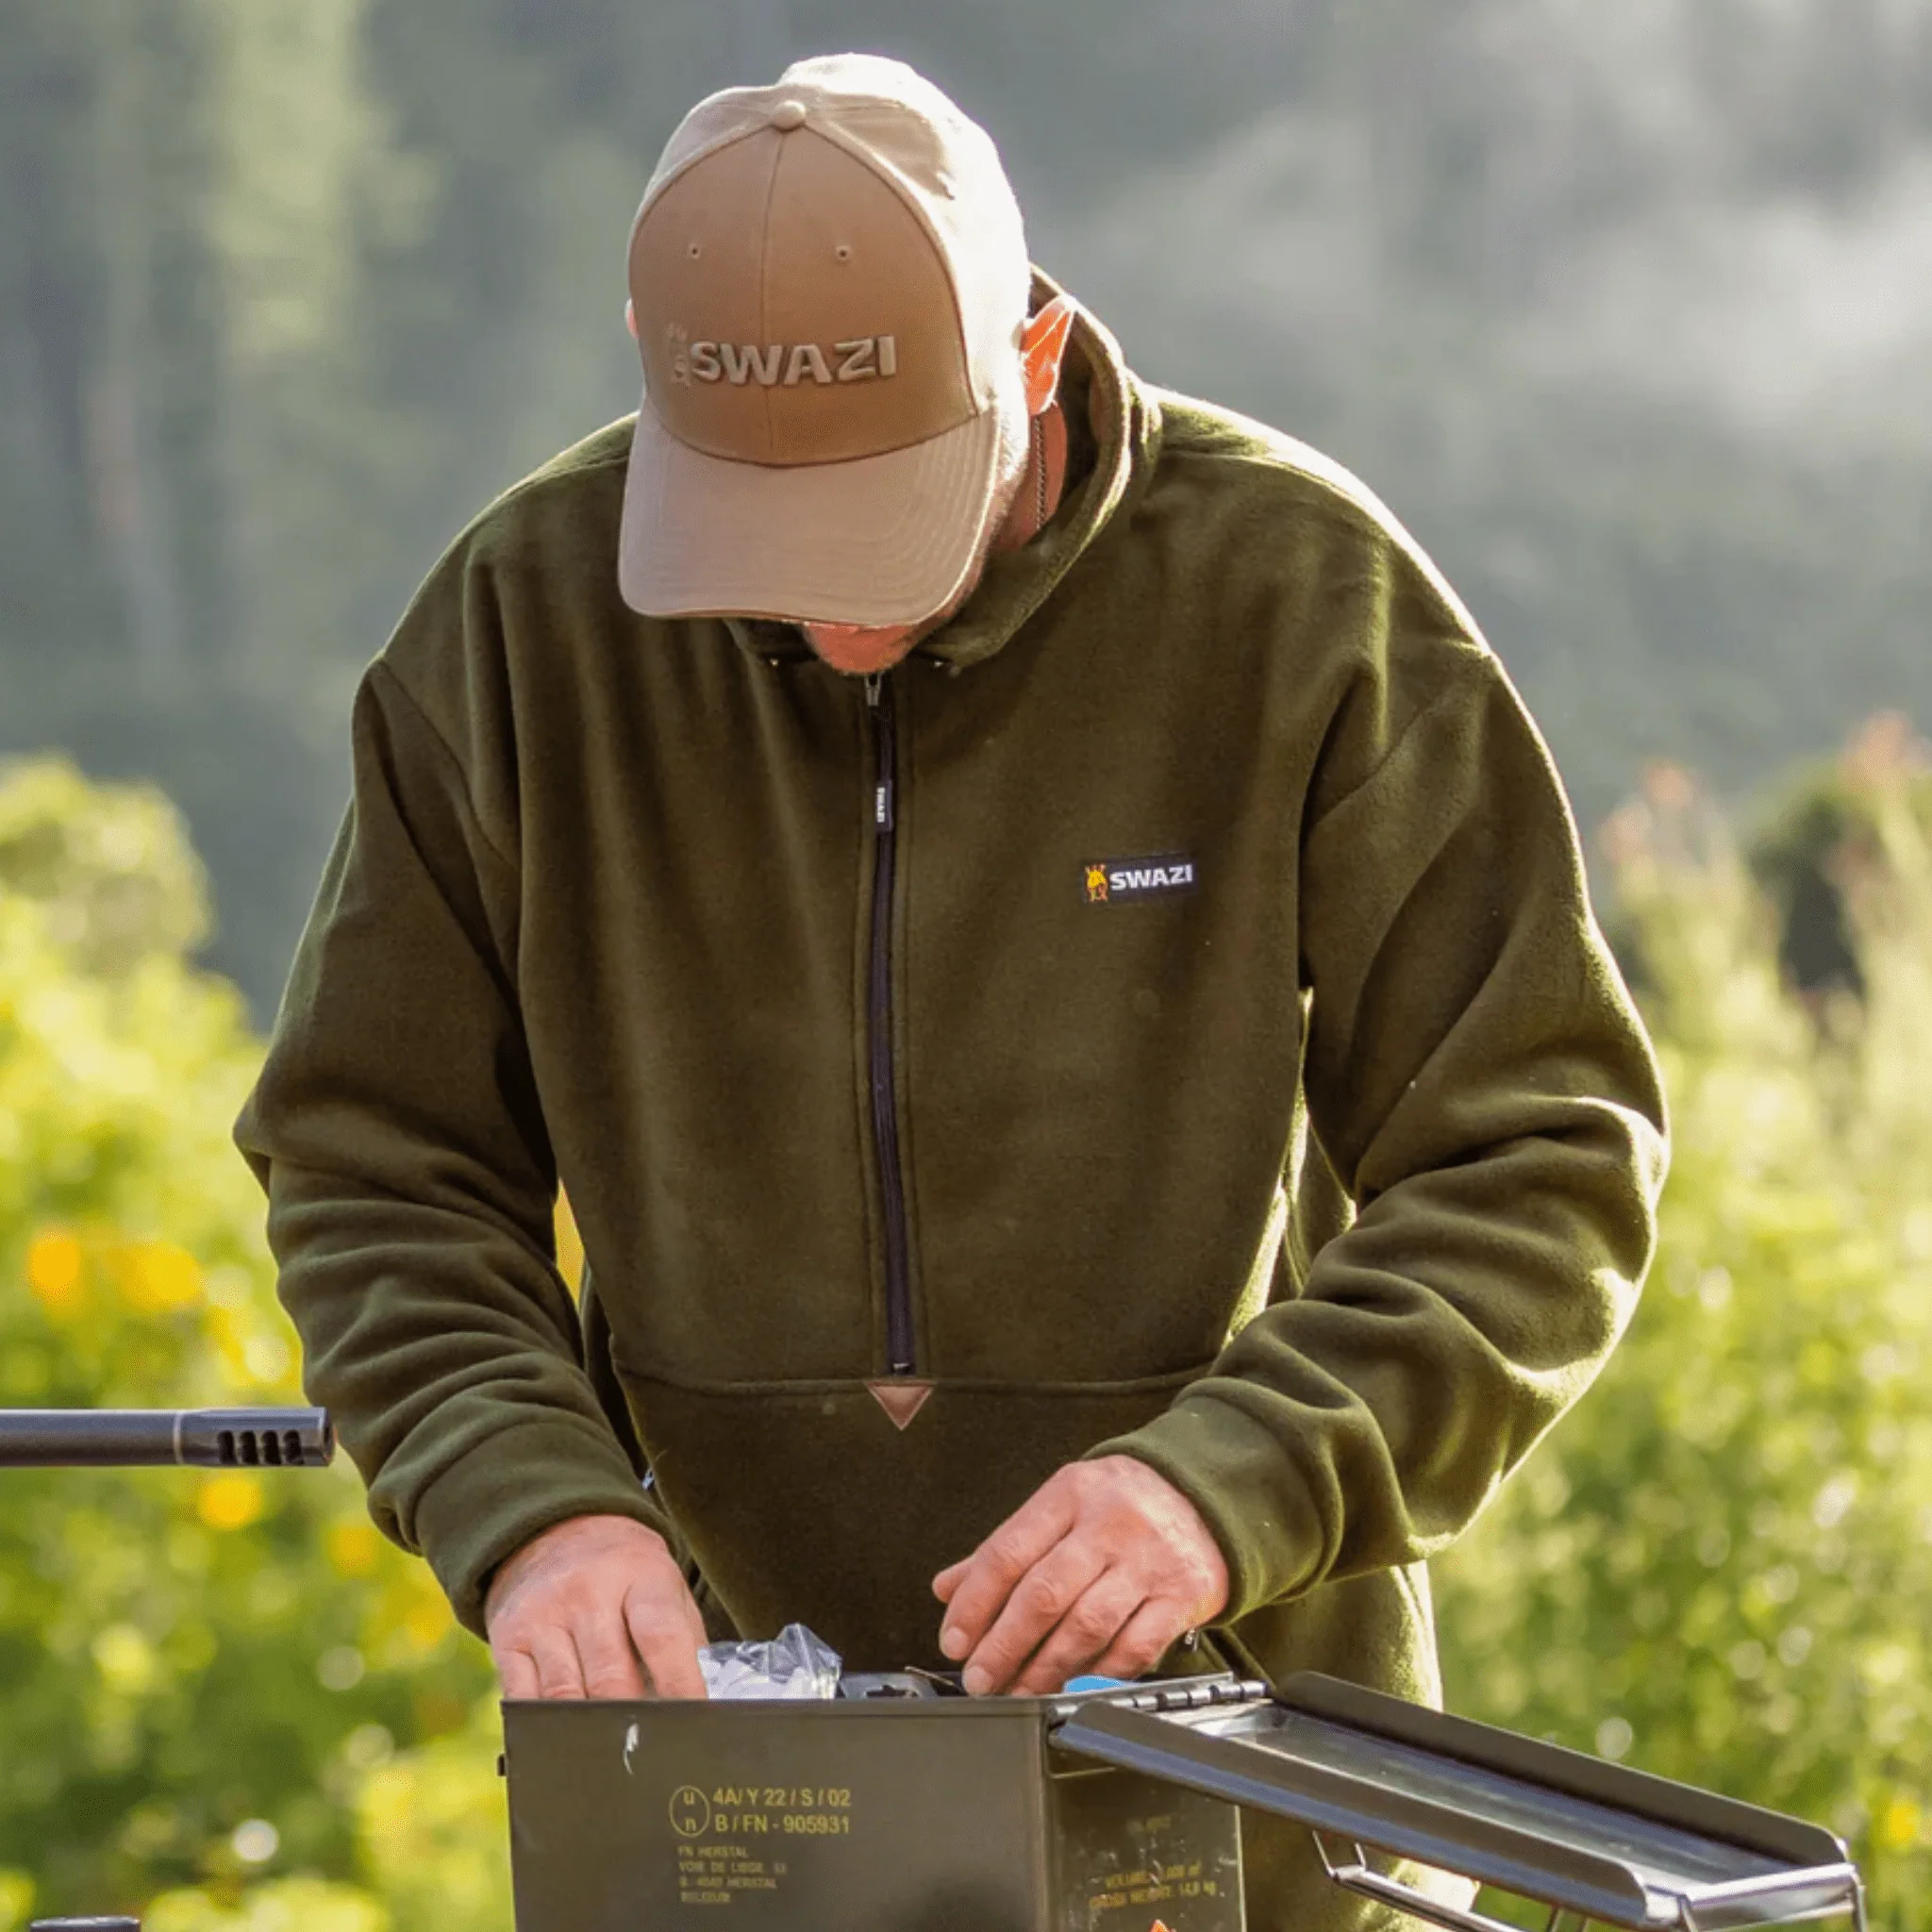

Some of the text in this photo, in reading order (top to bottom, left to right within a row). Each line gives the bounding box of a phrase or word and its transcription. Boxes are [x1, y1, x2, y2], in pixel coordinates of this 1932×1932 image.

[690, 335, 896, 387] SWAZI
[1109, 863, 1193, 891] SWAZI
[826, 1789, 851, 1807] 02
